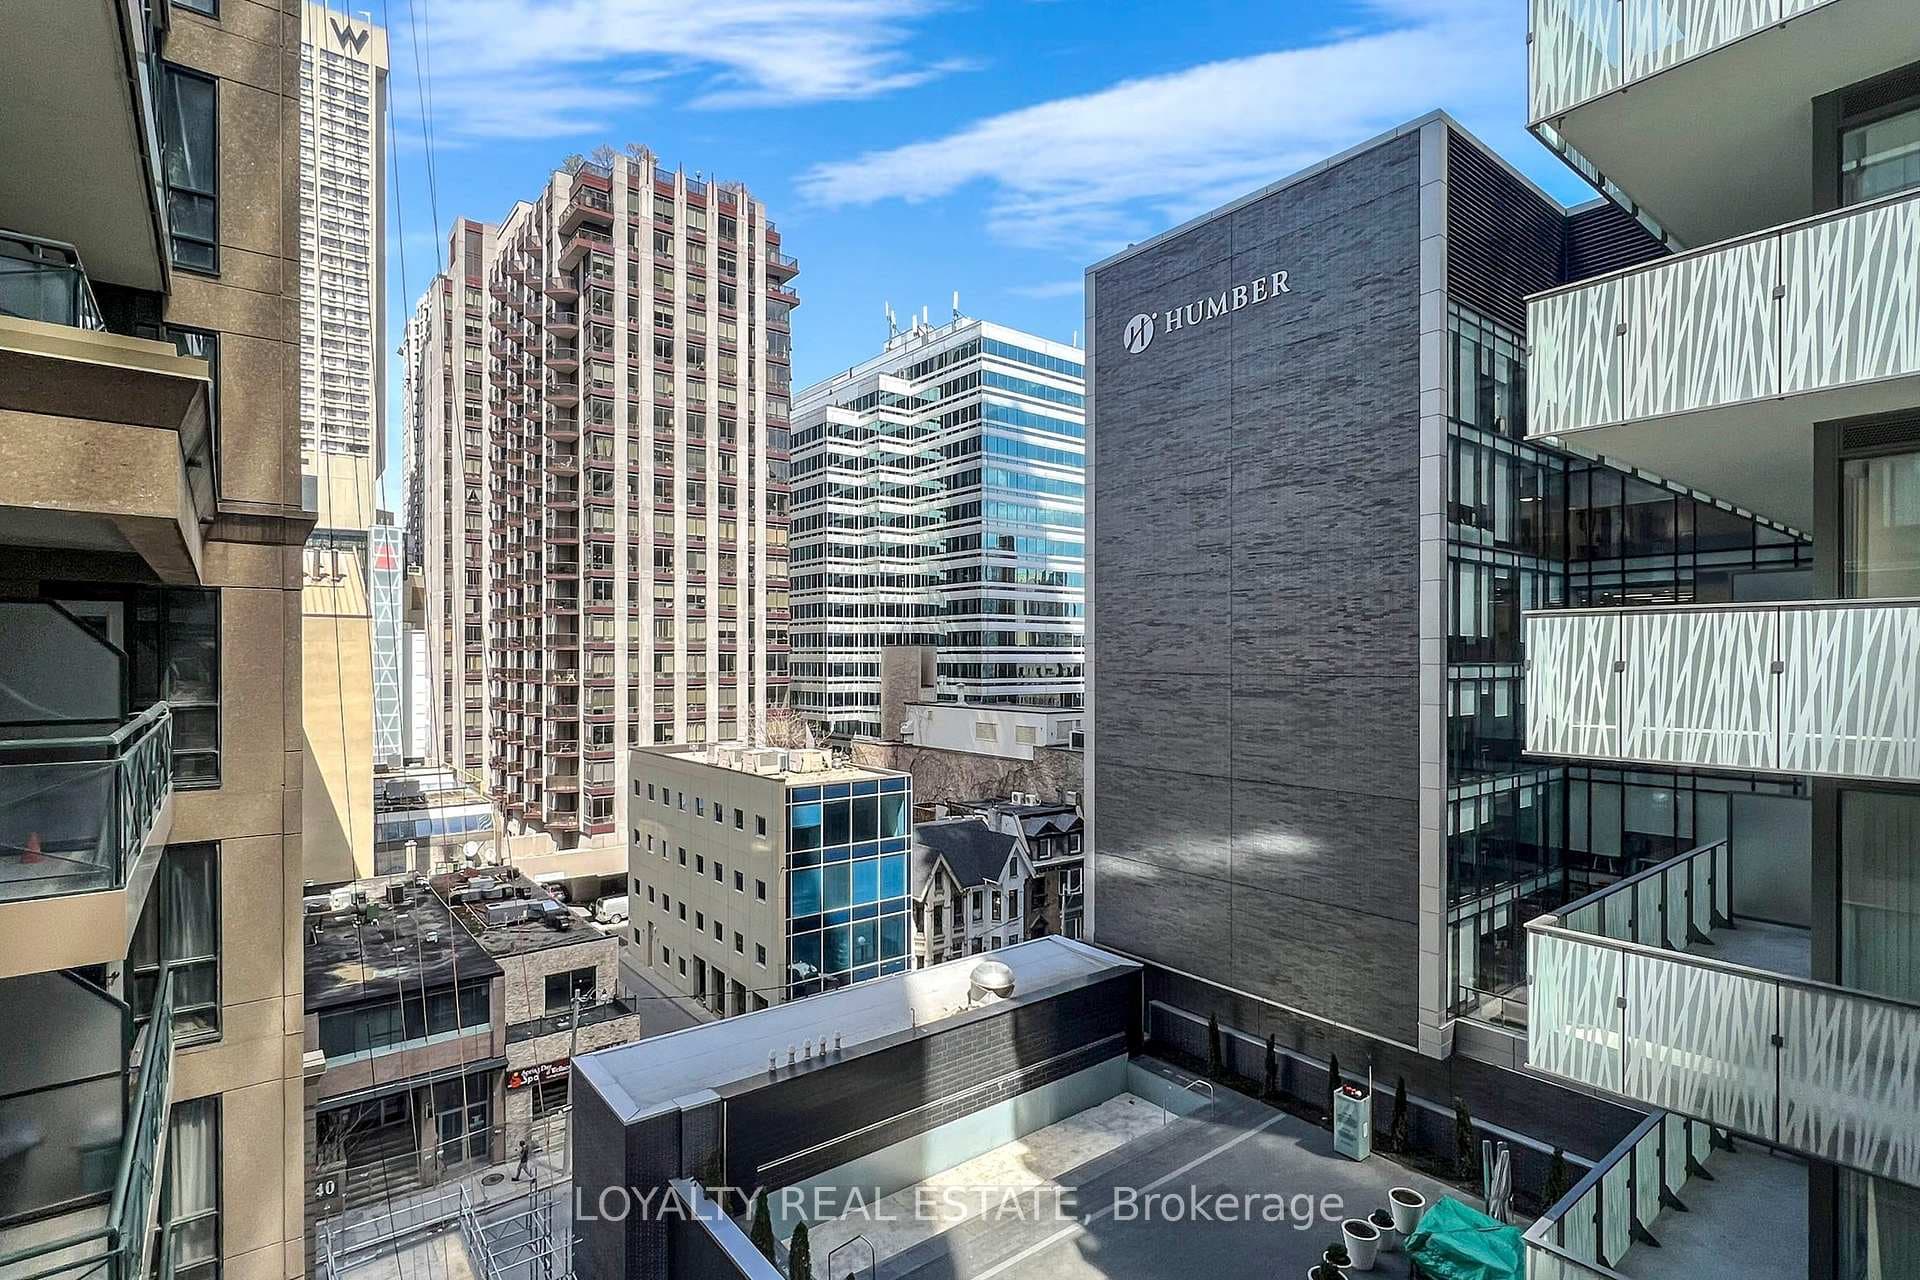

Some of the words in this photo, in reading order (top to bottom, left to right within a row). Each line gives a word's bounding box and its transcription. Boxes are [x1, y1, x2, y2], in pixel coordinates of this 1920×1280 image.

[329, 16, 370, 55] W
[1164, 270, 1291, 334] HUMBER
[314, 1180, 335, 1197] 40
